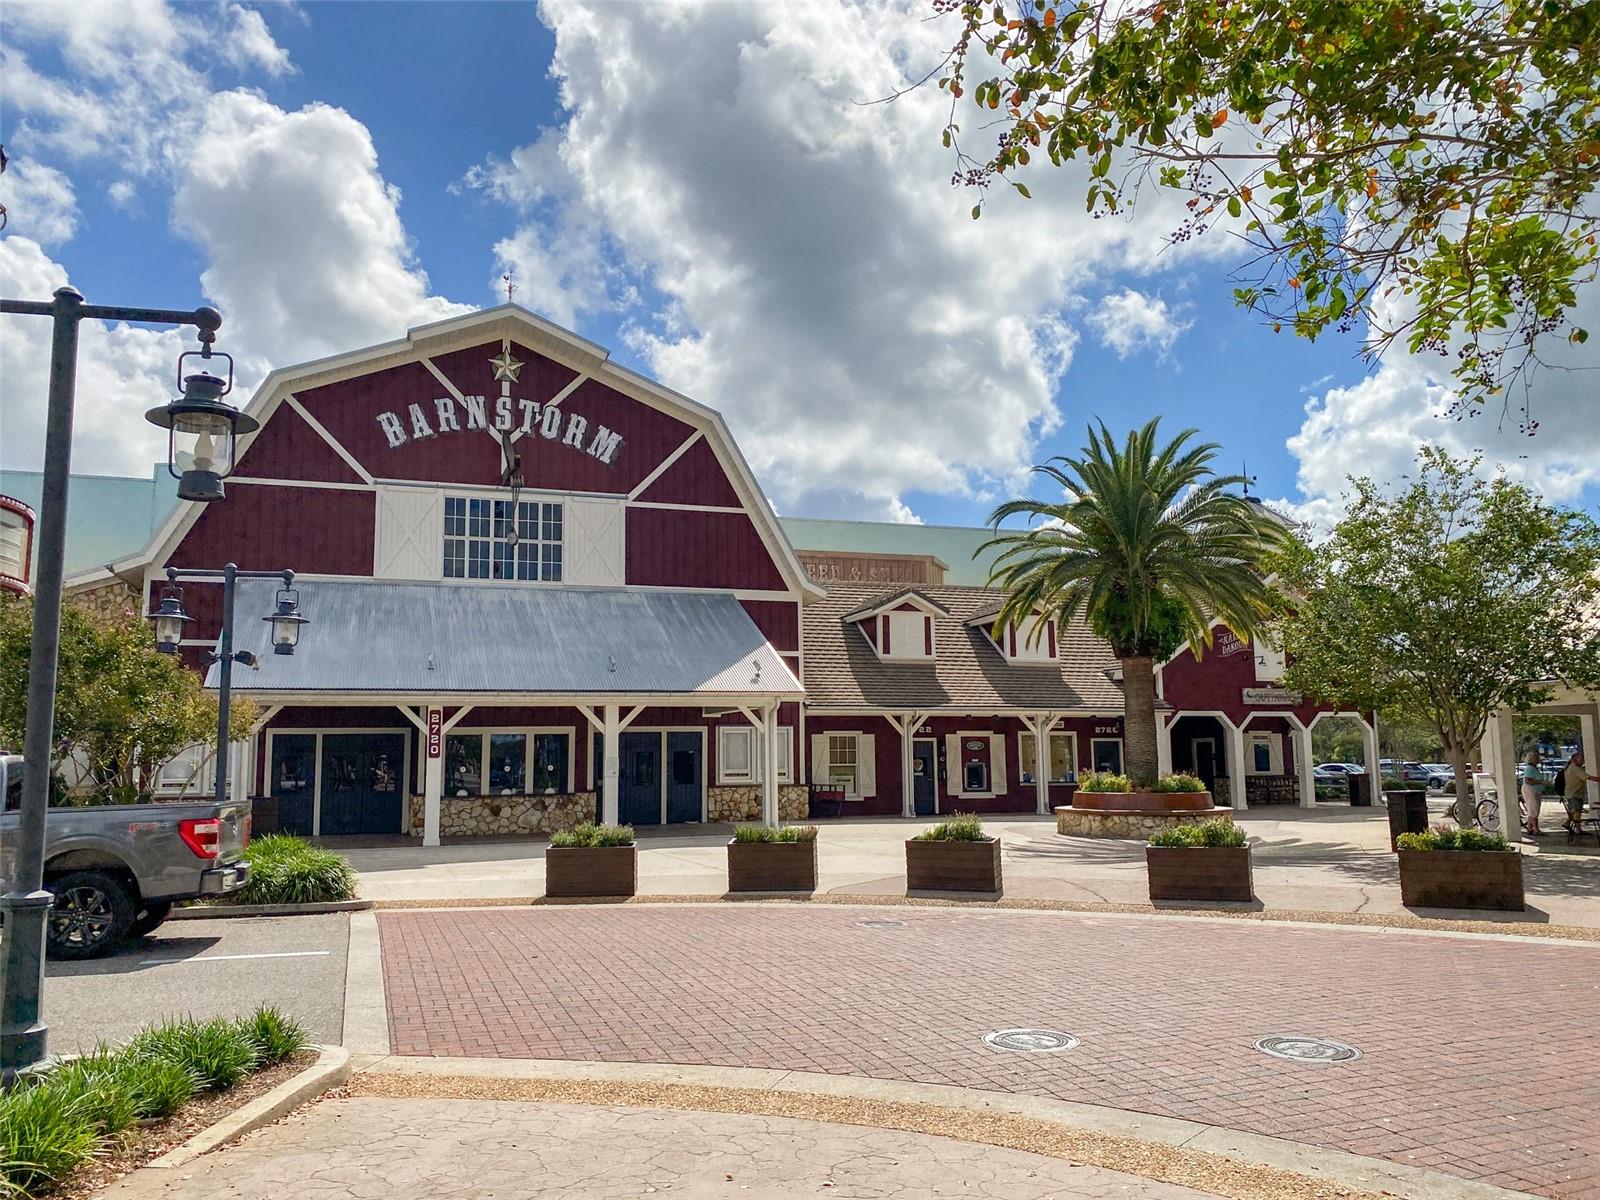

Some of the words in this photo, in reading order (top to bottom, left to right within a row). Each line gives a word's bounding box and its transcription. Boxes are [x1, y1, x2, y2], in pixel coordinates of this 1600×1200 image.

[376, 395, 623, 464] BARNSTORM
[803, 562, 840, 580] EED
[848, 566, 862, 580] &
[1254, 691, 1299, 703] OUTHOU
[430, 713, 440, 754] 2720
